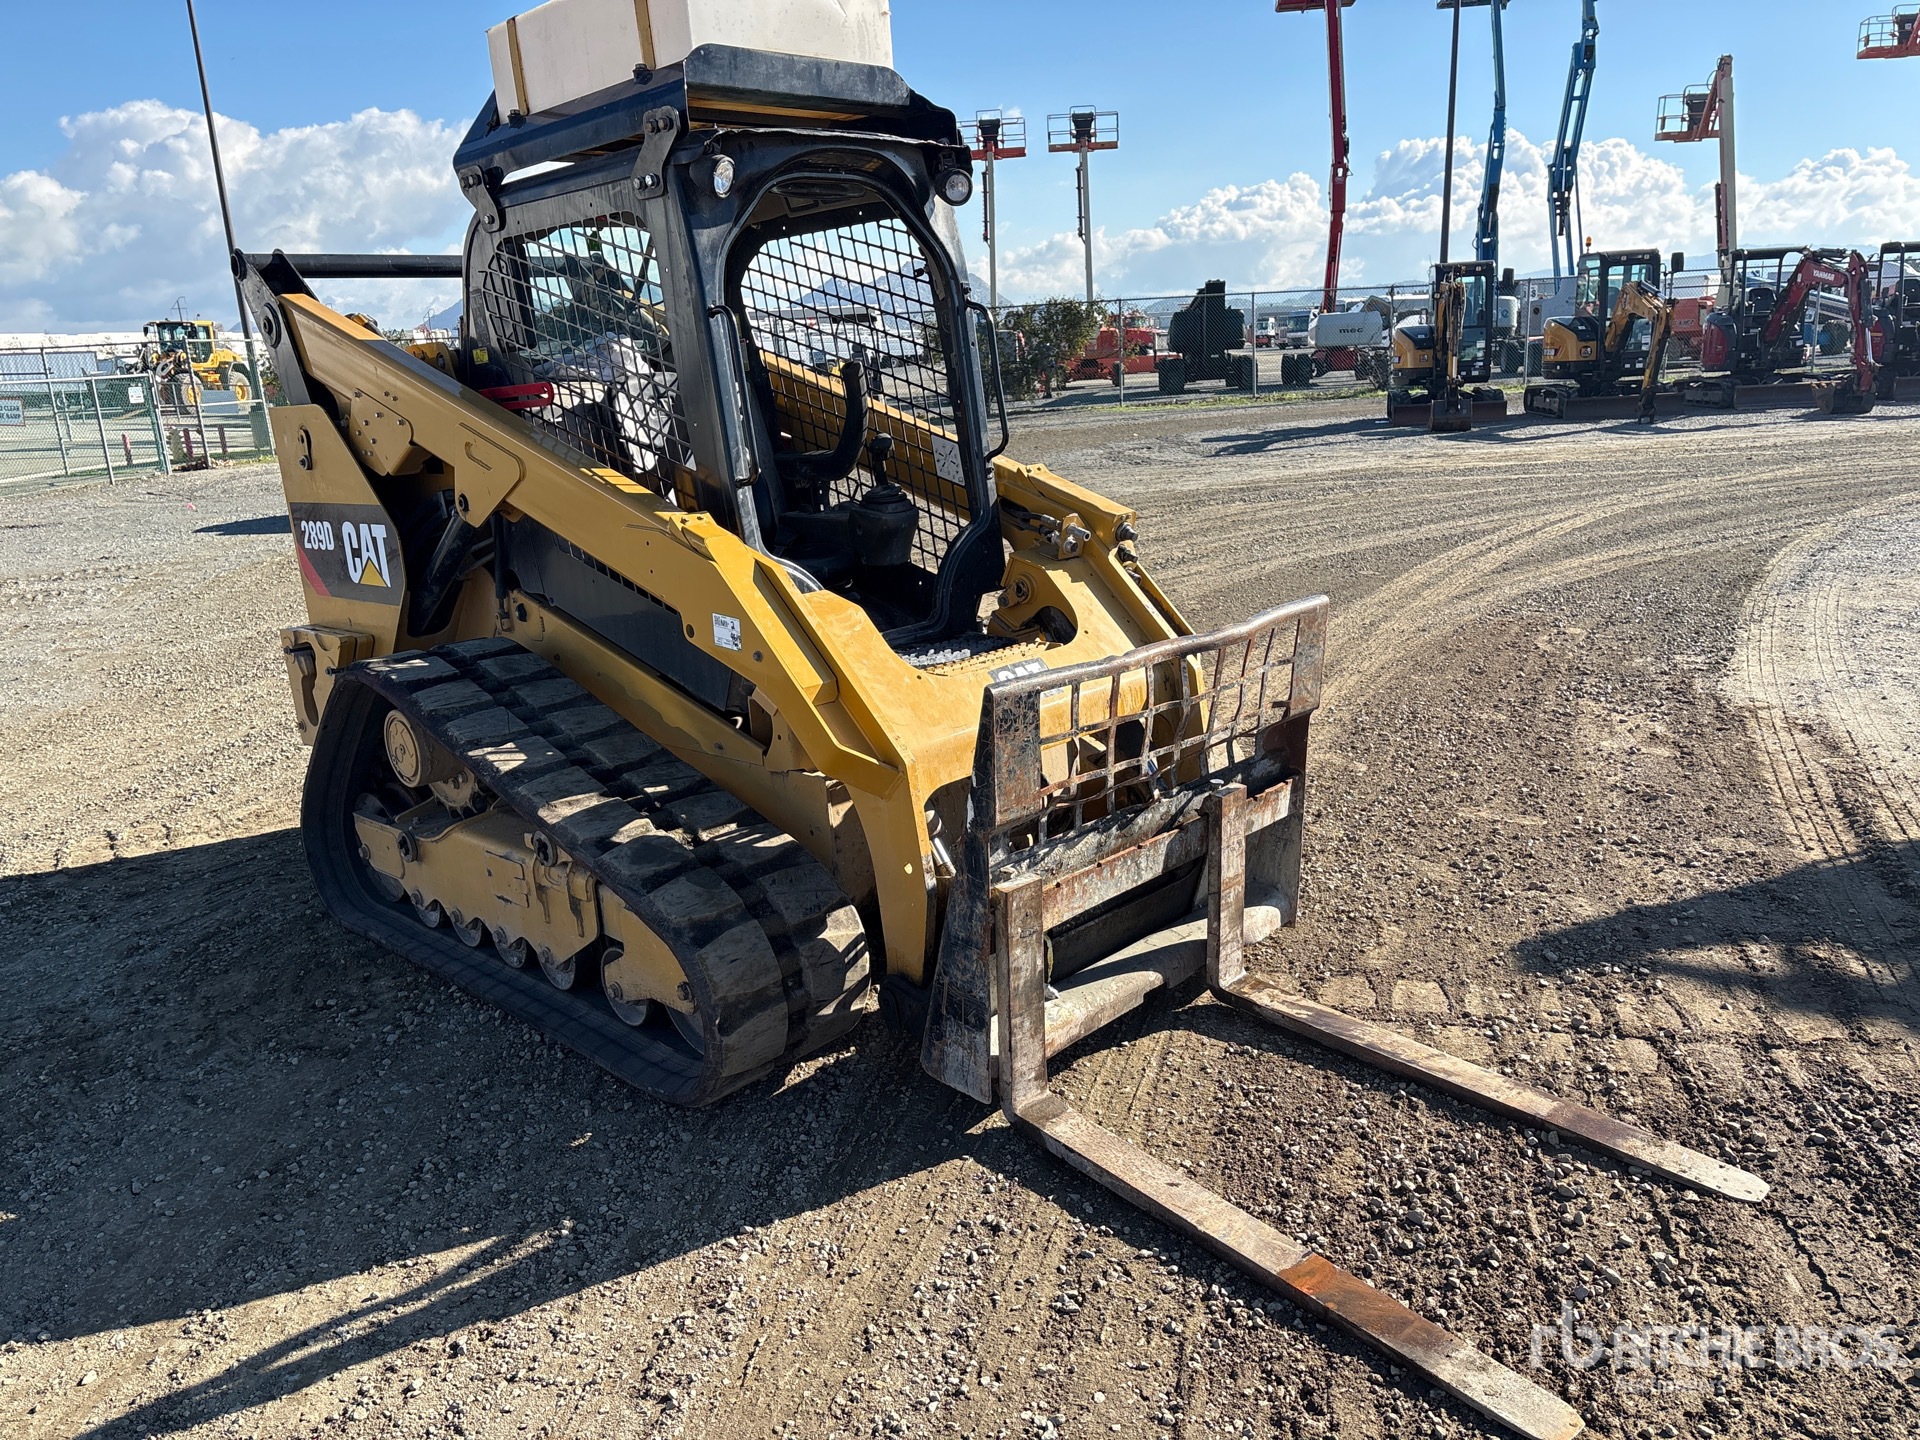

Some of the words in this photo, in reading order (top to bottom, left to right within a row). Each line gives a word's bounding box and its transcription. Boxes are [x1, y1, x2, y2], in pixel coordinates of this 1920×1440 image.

[1813, 269, 1835, 281] YANMAR
[301, 520, 334, 550] 289D
[342, 521, 391, 587] CAT
